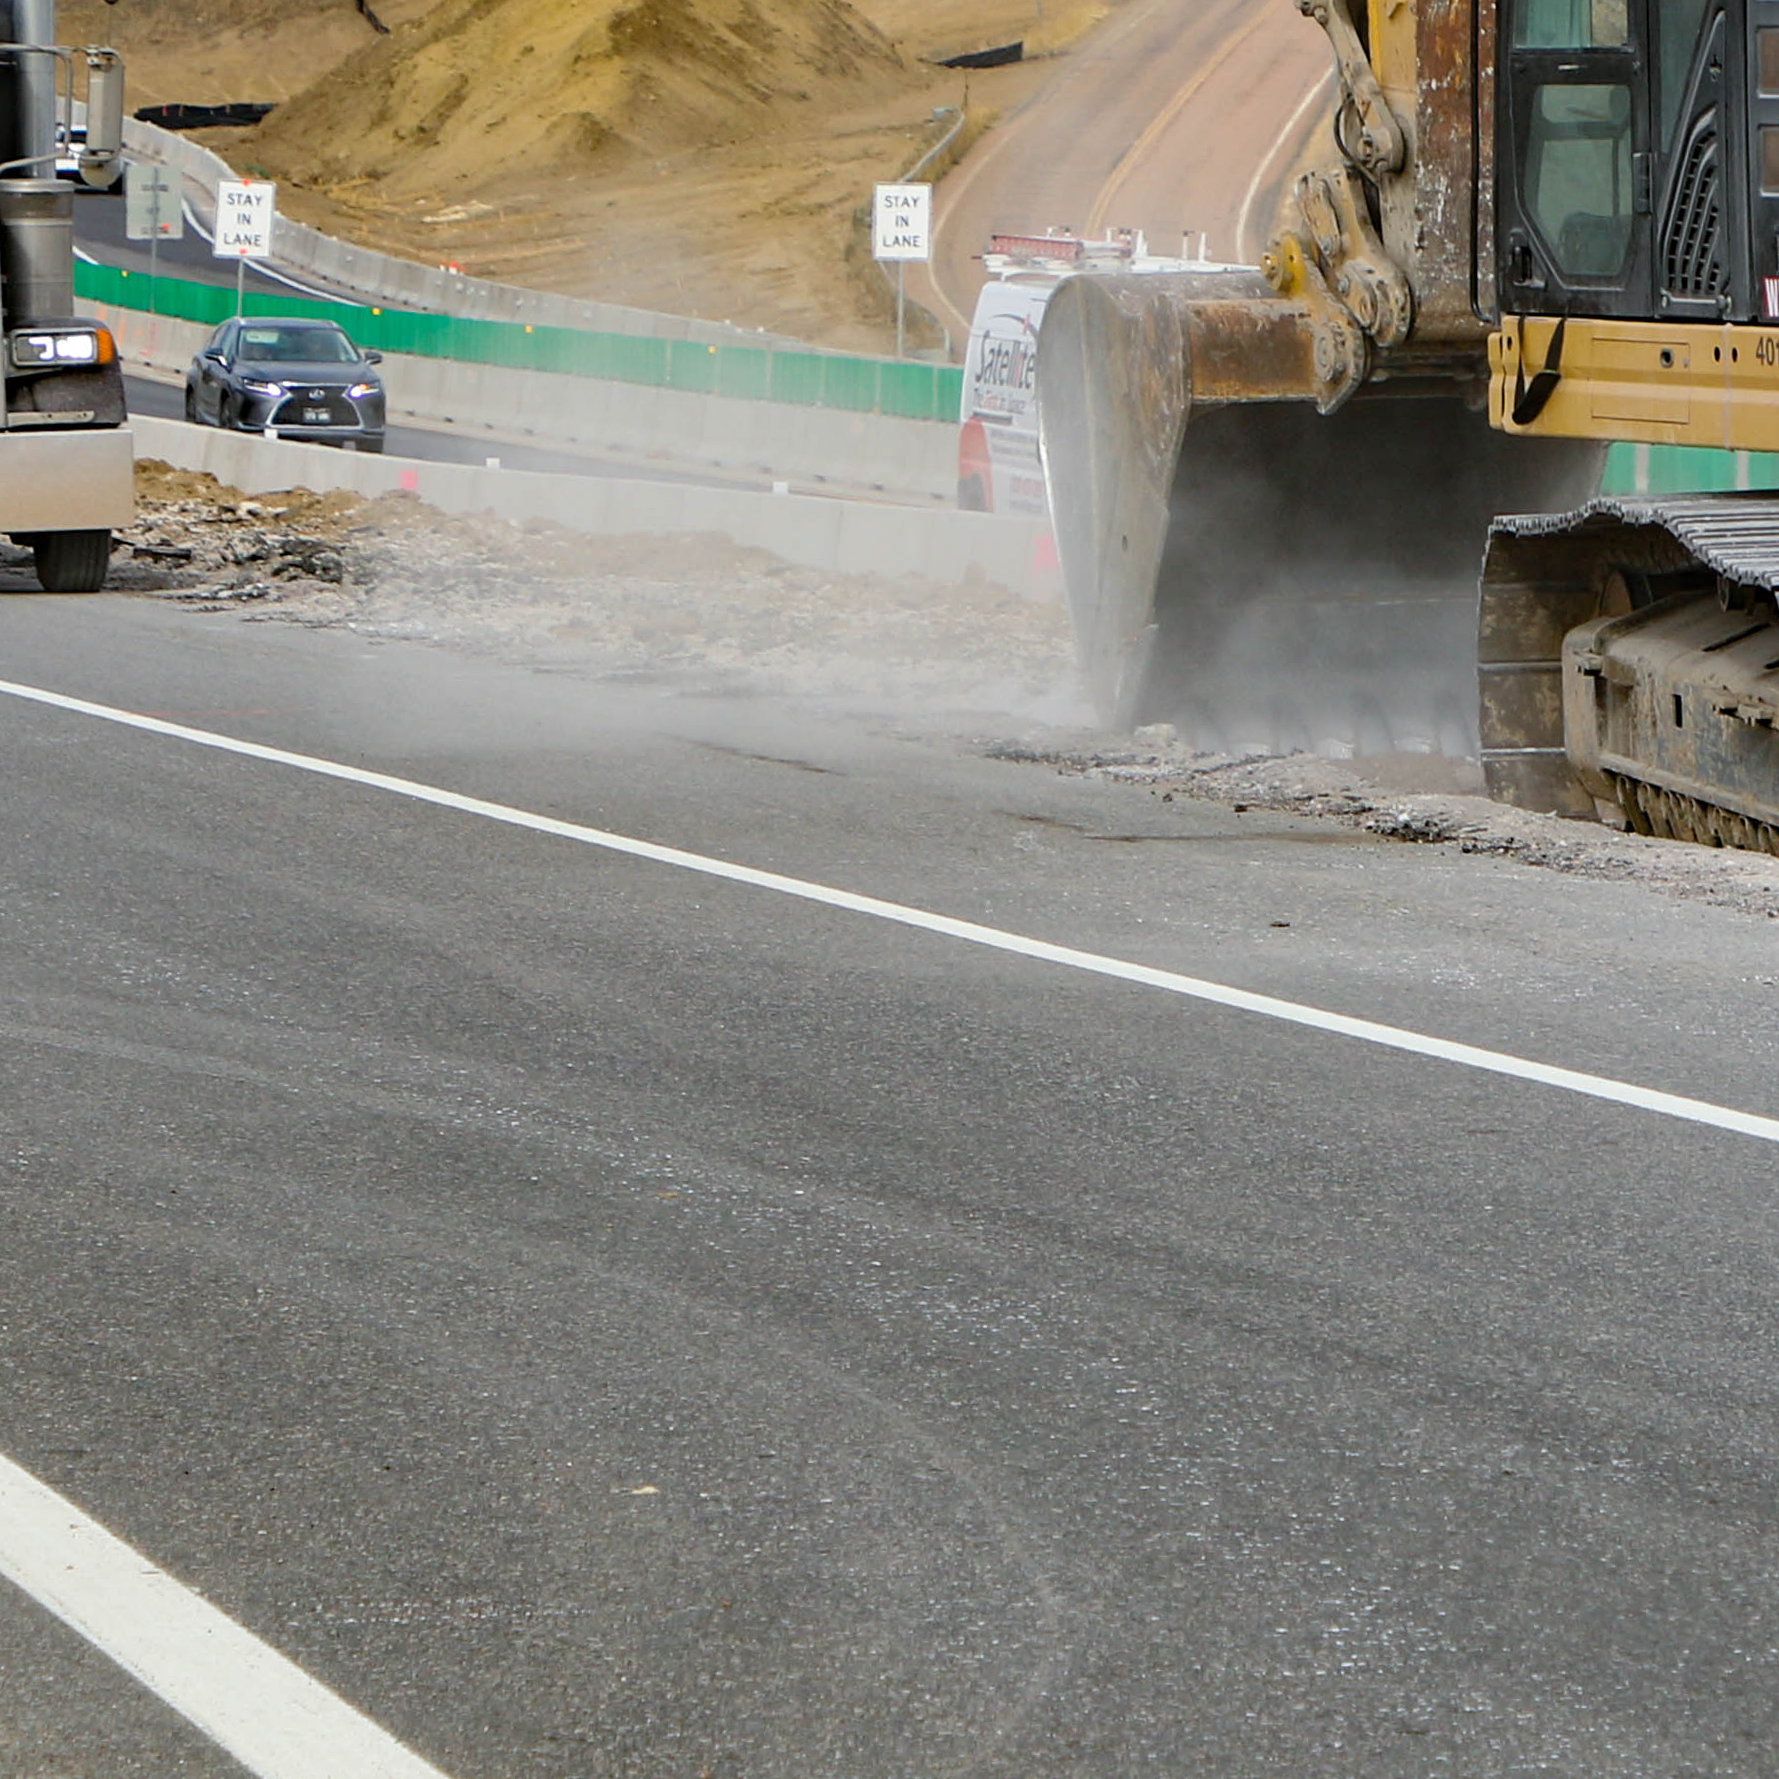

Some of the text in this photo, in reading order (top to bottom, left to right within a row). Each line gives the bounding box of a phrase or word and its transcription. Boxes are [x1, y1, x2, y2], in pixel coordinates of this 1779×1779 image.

[227, 192, 262, 206] STAY
[884, 195, 920, 208] STAY
[237, 213, 252, 226] IN
[895, 214, 909, 228] IN
[224, 233, 262, 247] LANE
[883, 234, 921, 248] LANE
[975, 330, 1036, 390] Satellite
